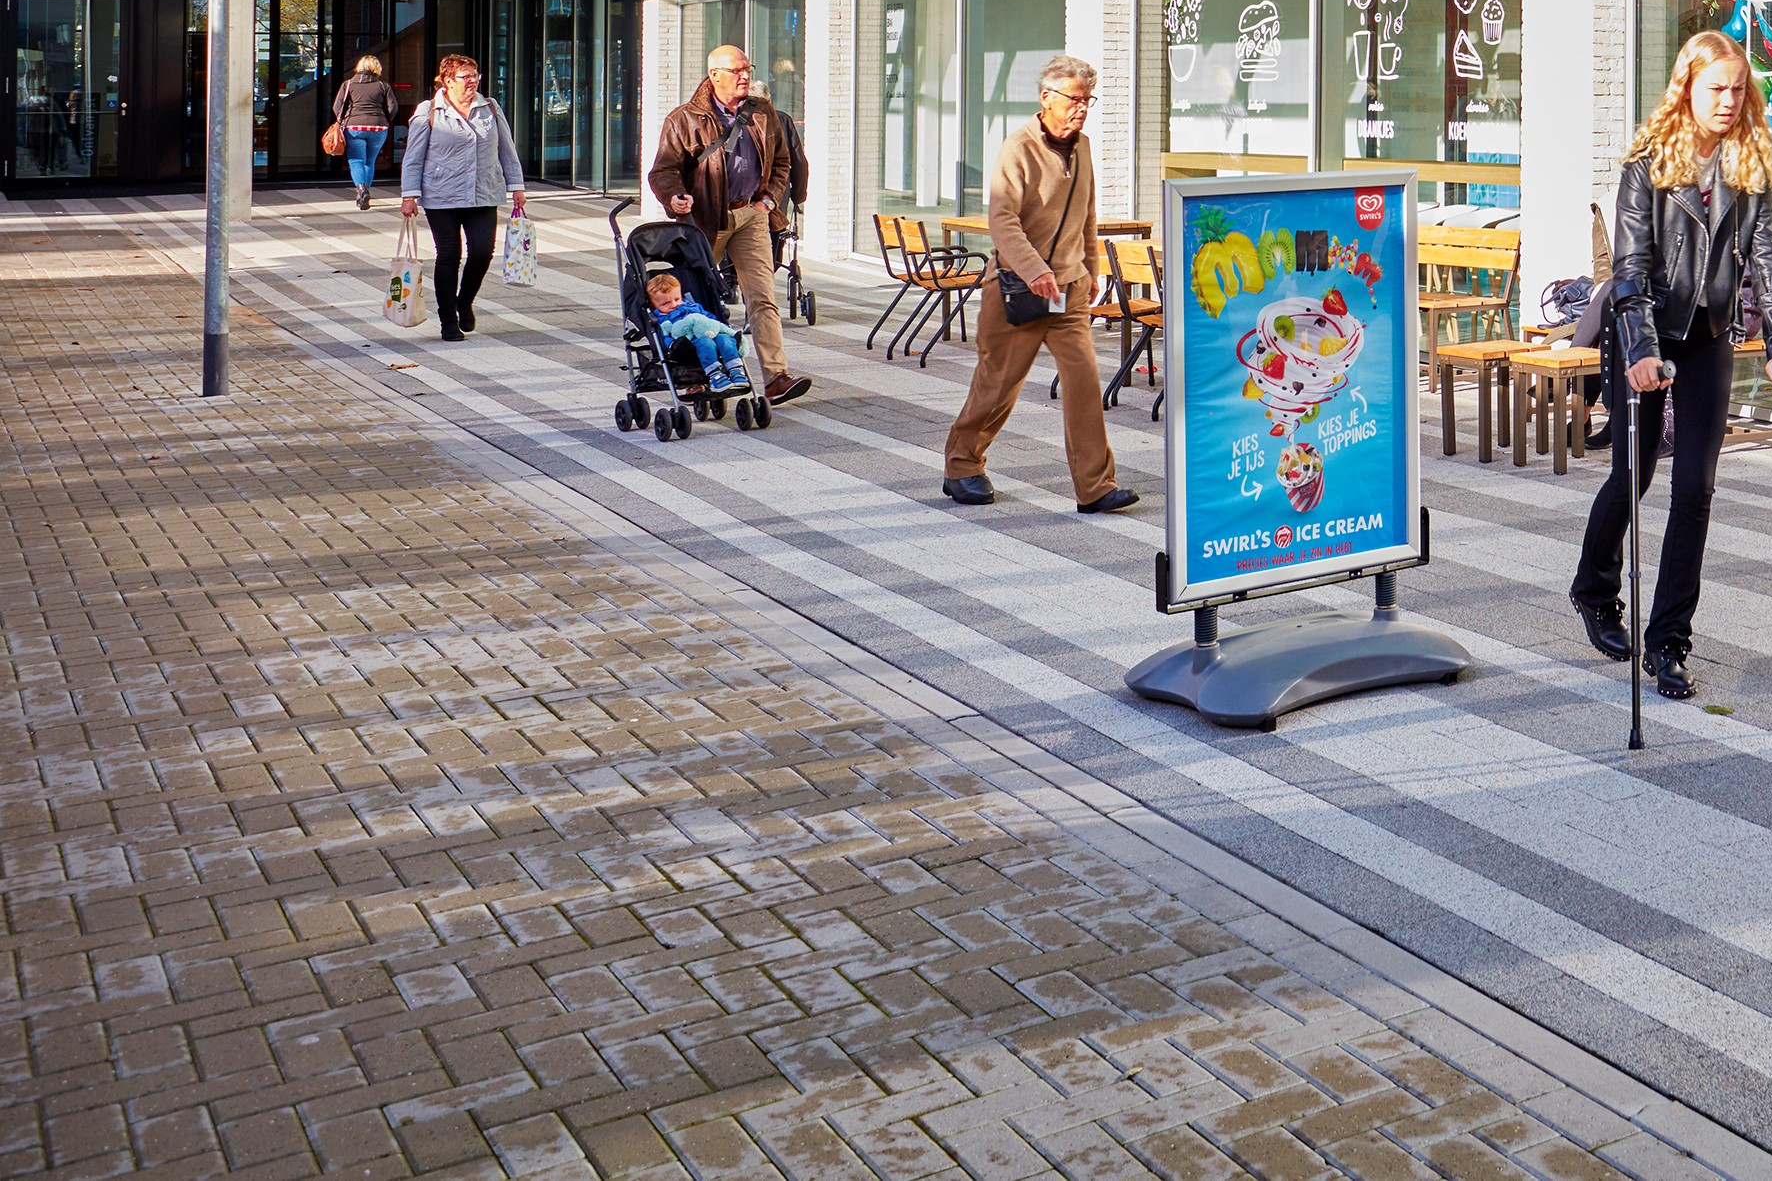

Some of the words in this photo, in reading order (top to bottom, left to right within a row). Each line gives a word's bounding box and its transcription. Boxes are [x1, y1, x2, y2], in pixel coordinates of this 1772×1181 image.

[1359, 211, 1382, 221] SWIRL'S
[1317, 414, 1343, 440] KIES
[1347, 407, 1359, 427] JE
[1323, 419, 1377, 456] TOPPINGS
[1232, 433, 1259, 459] KIES
[1227, 459, 1242, 480] JE
[1245, 450, 1265, 473] IJS
[1202, 529, 1271, 558] SWIRL'S
[1296, 523, 1321, 542] ICE
[1324, 513, 1383, 536] CREAM
[1236, 556, 1269, 572] PRECIES
[1271, 552, 1295, 566] WAAR
[1298, 549, 1307, 561] JE
[1310, 546, 1322, 559] ZIN
[1325, 544, 1332, 556] IN
[1335, 541, 1353, 554] HEBT
